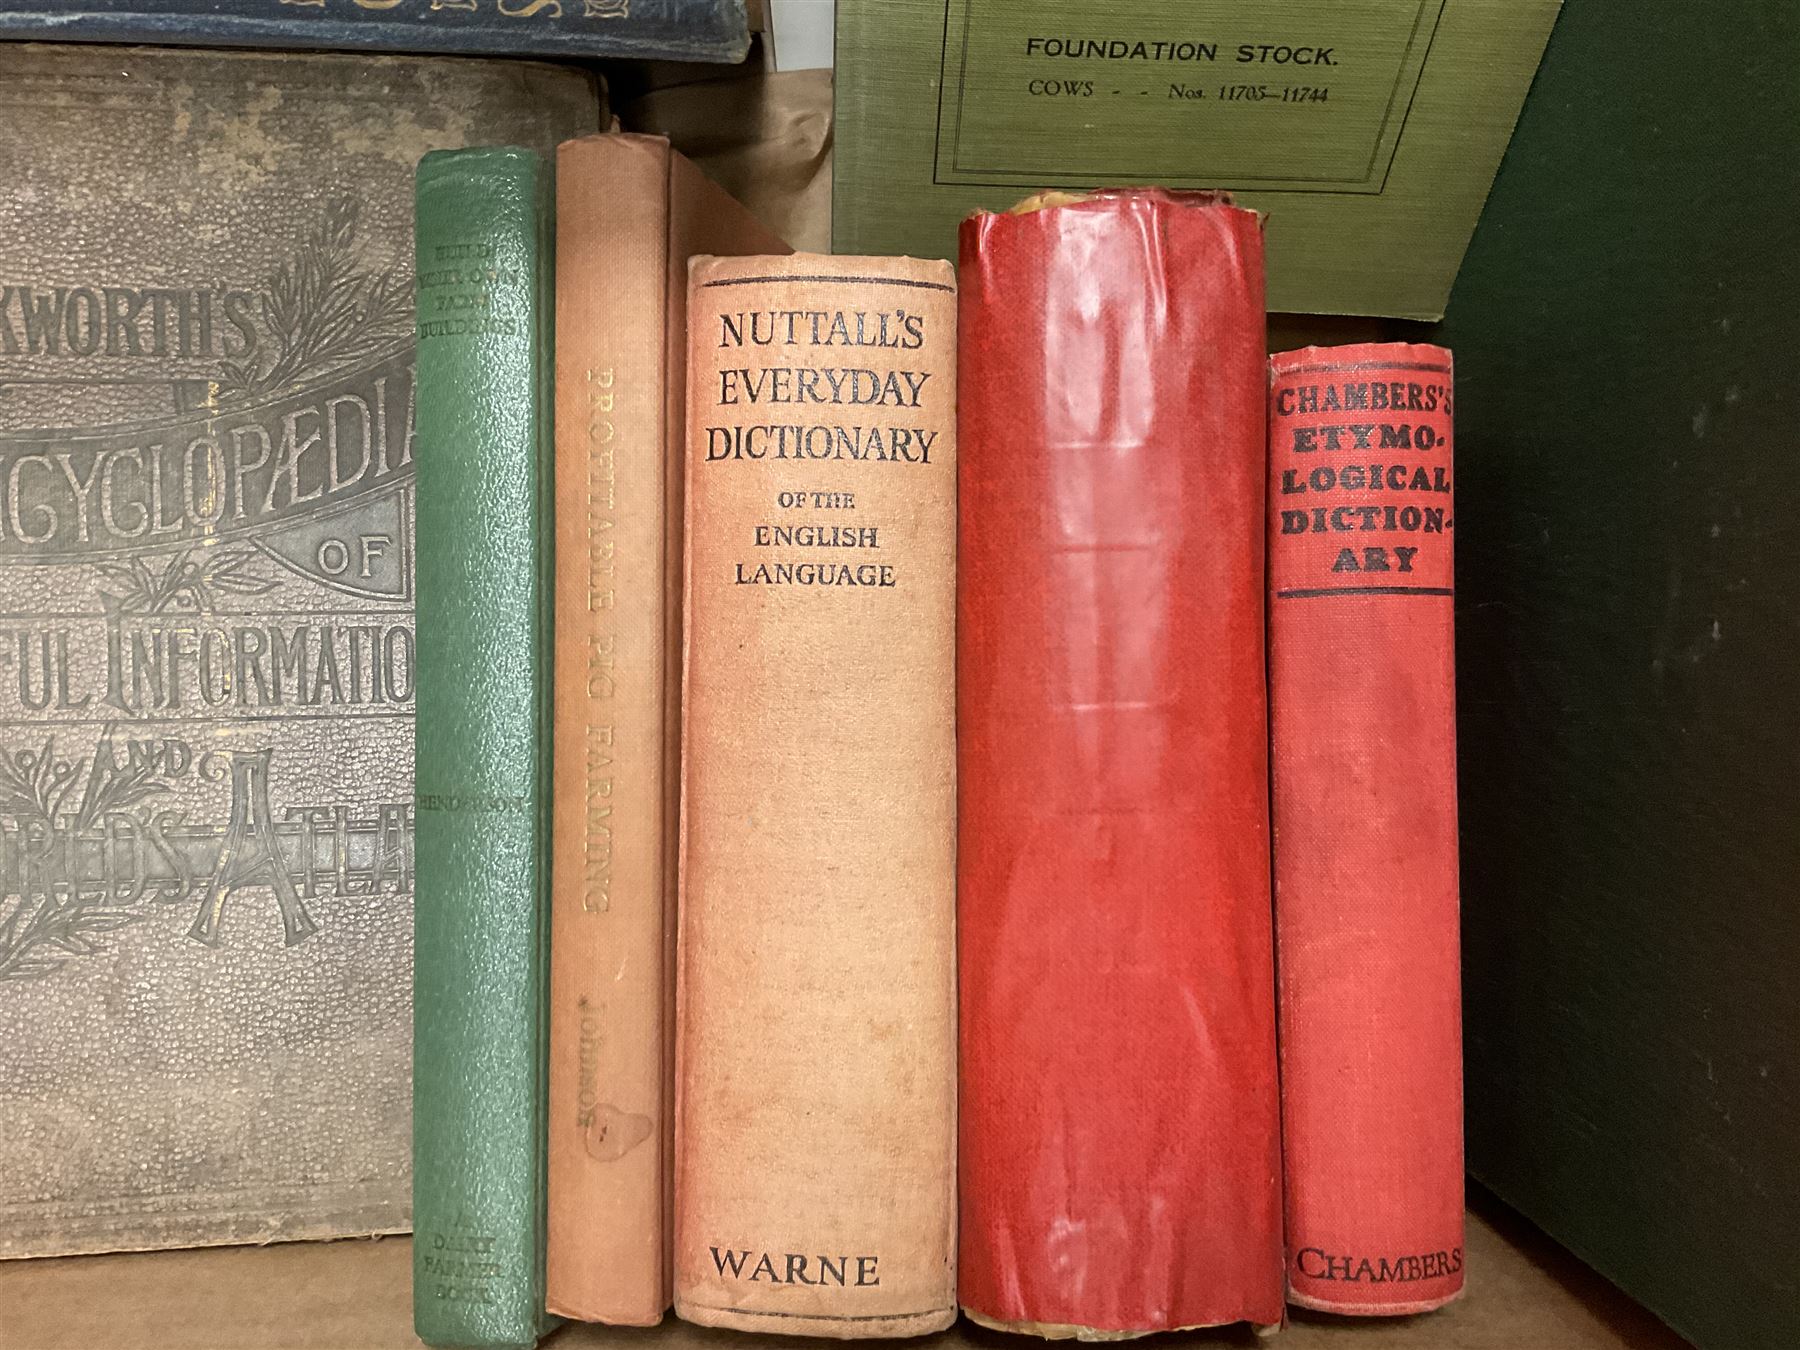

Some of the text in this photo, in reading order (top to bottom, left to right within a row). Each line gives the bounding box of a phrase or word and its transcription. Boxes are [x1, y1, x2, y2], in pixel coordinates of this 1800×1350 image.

[1026, 37, 1338, 66] FOUNDATION STOCK.
[1029, 79, 1094, 97] COWS
[1168, 84, 1206, 100] Nos.
[718, 310, 924, 349] NUTTALL'S
[717, 368, 932, 407] EVERYDAY
[1276, 382, 1453, 416] CHAMBERS'S
[705, 426, 938, 464] DICTIONARY
[587, 367, 615, 612] PROFITABLE
[1281, 464, 1451, 495] LOGICAL
[777, 492, 856, 509] OF THE
[754, 526, 881, 549] ENGLISH
[317, 536, 392, 578] OF
[735, 563, 897, 587] LANGUAGE
[1331, 547, 1419, 573] ARY
[587, 634, 614, 698] PIG
[583, 724, 614, 913] FARMING
[709, 1246, 880, 1287] WARNE
[1296, 1247, 1463, 1284] CHAMBERS
